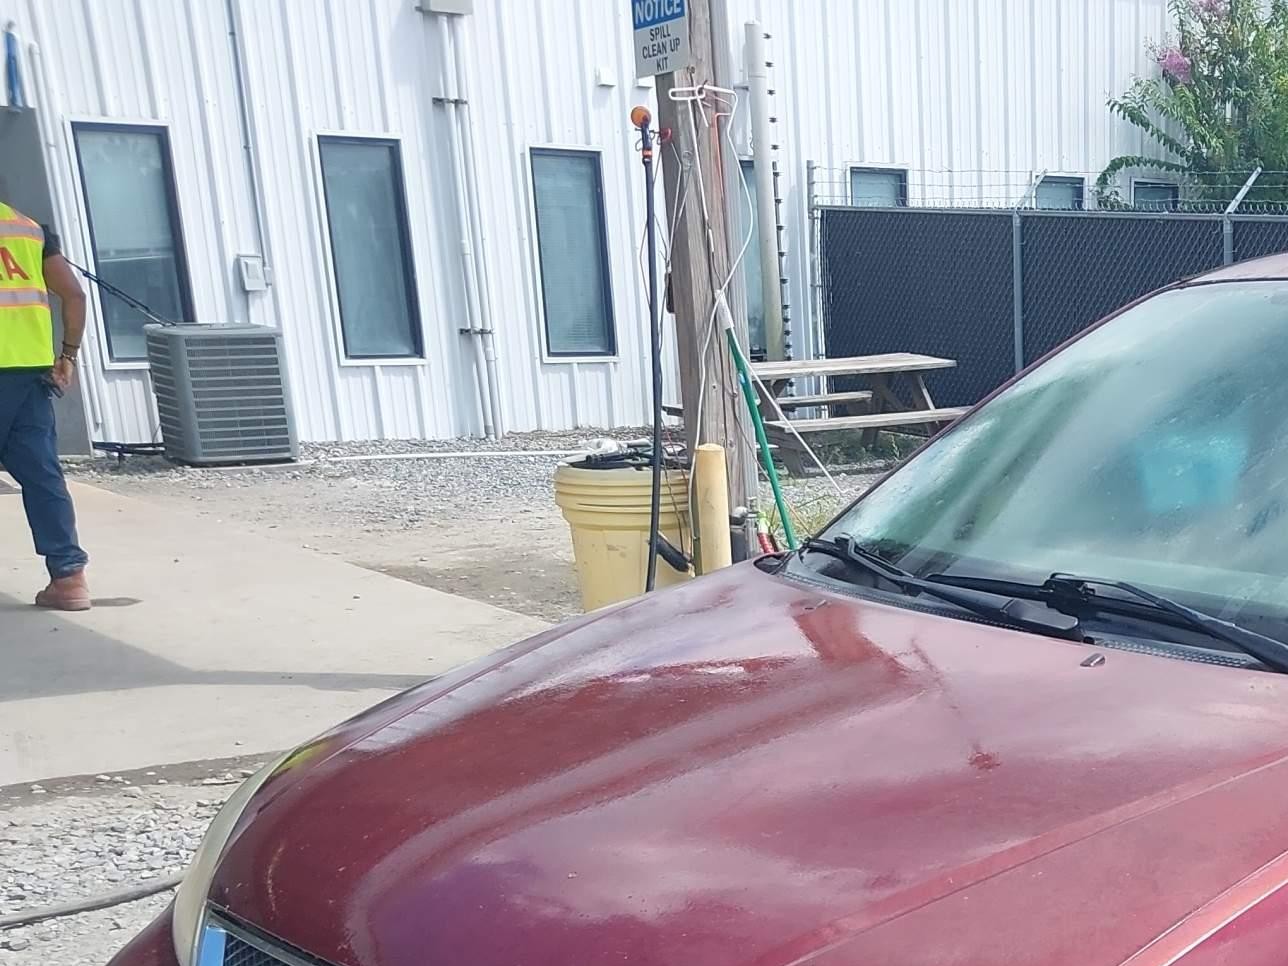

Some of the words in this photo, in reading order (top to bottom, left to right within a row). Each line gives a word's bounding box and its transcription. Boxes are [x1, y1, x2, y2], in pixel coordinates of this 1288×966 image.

[635, 0, 682, 25] NOTICE
[649, 24, 671, 42] SPILL
[642, 41, 668, 60] CLEAN
[669, 37, 681, 53] UP
[656, 56, 669, 73] KIT
